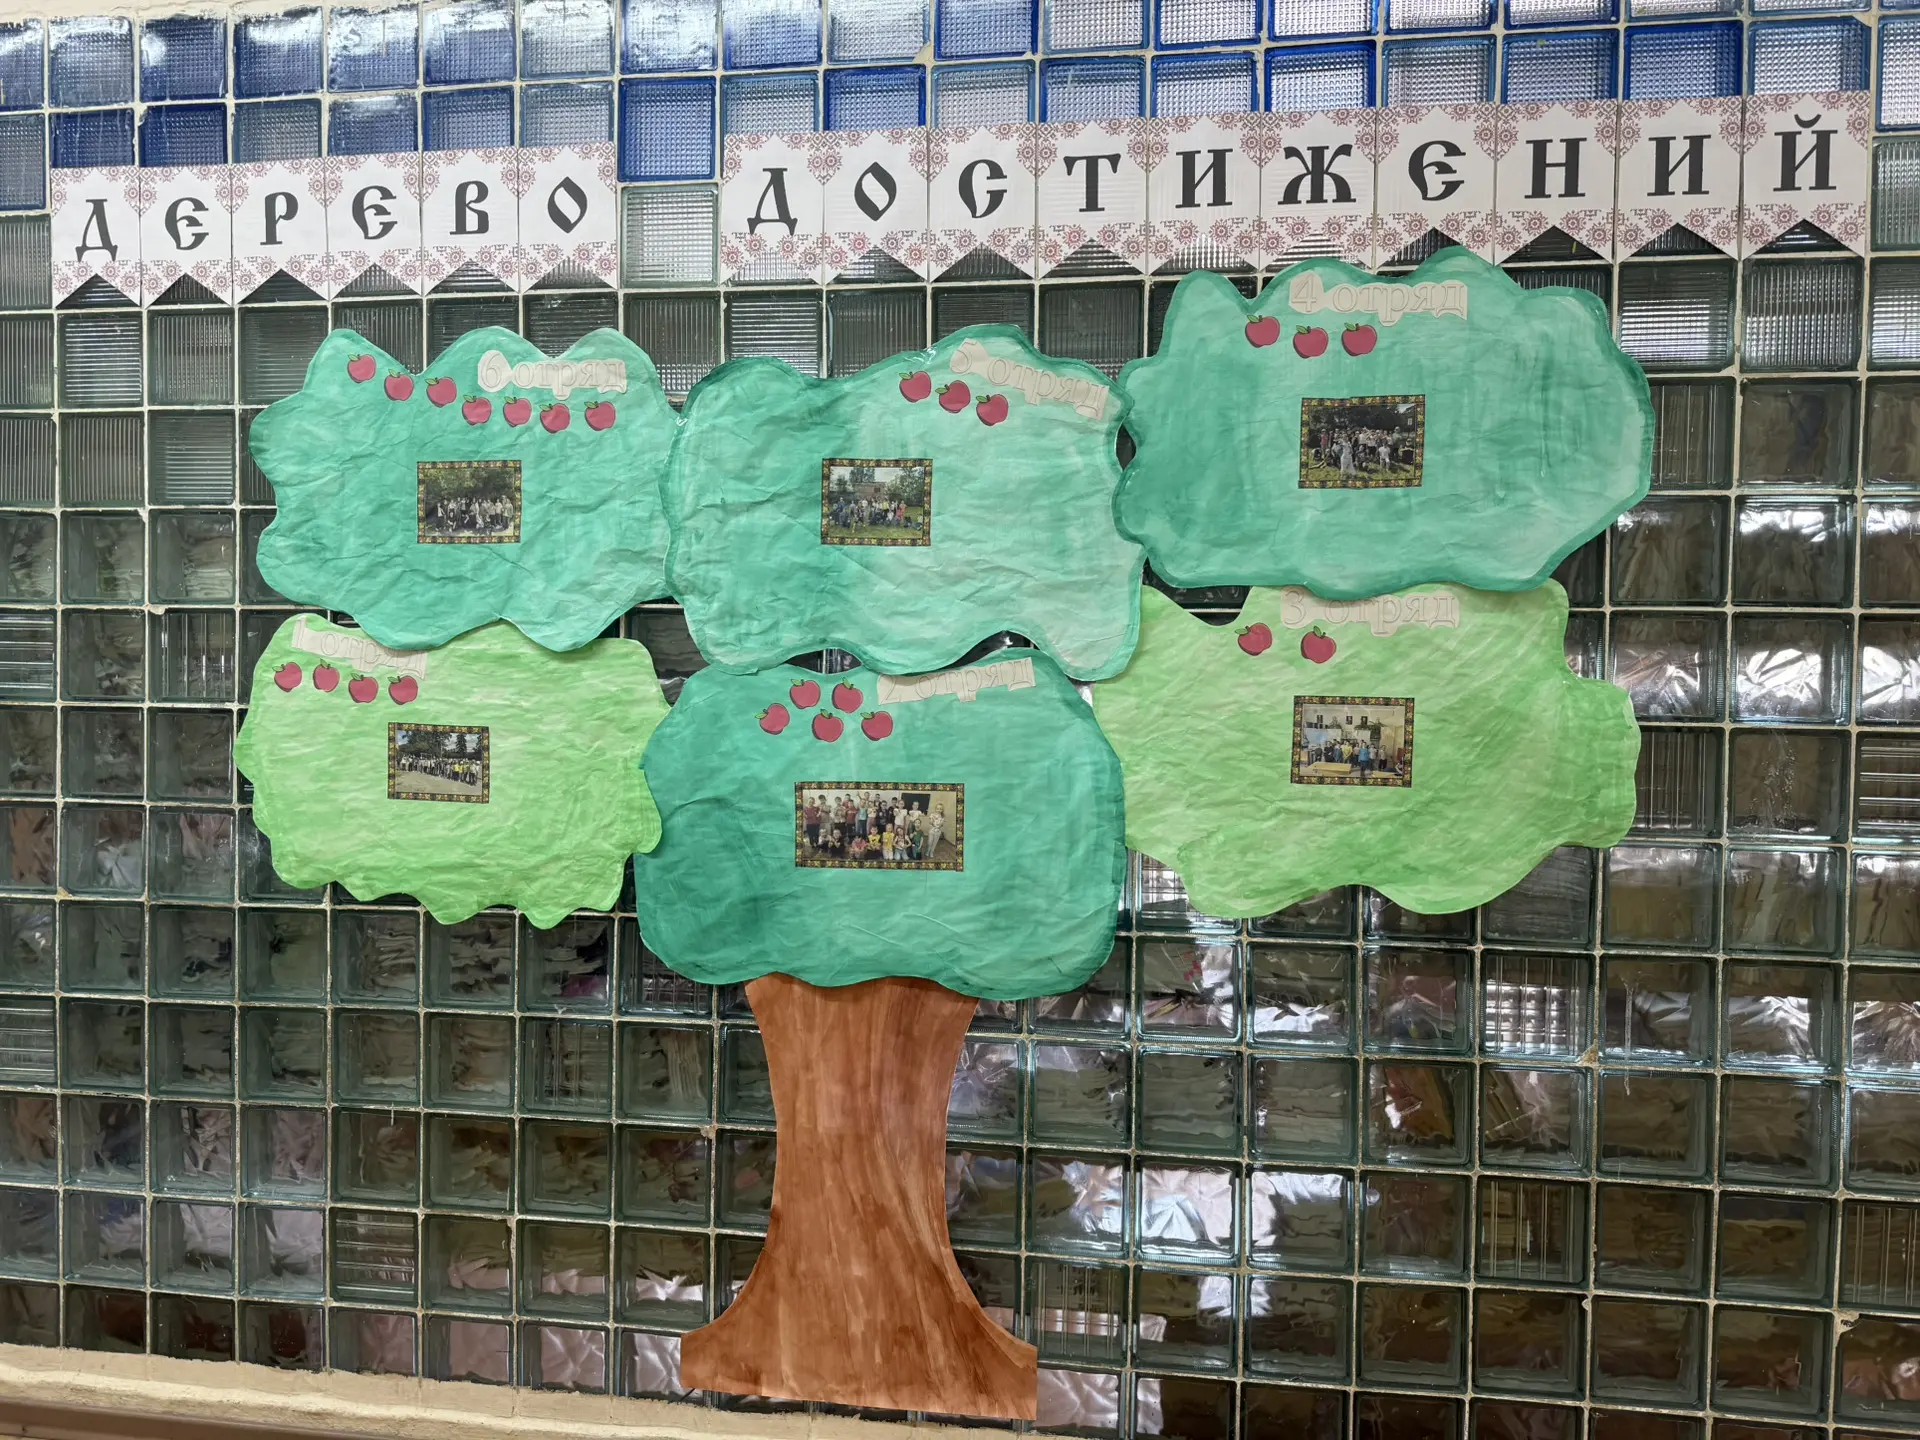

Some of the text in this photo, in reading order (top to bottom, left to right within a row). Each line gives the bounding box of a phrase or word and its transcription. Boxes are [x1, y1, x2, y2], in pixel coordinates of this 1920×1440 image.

[76, 114, 1839, 261] ДЕРЕВО ДОСТИЖЕНИЙ
[1290, 272, 1465, 323] 4 отряд
[480, 352, 626, 399] 6 отряд
[987, 357, 1107, 419] отряд
[1283, 589, 1456, 634] 3 отряд
[915, 658, 1036, 702] отряд
